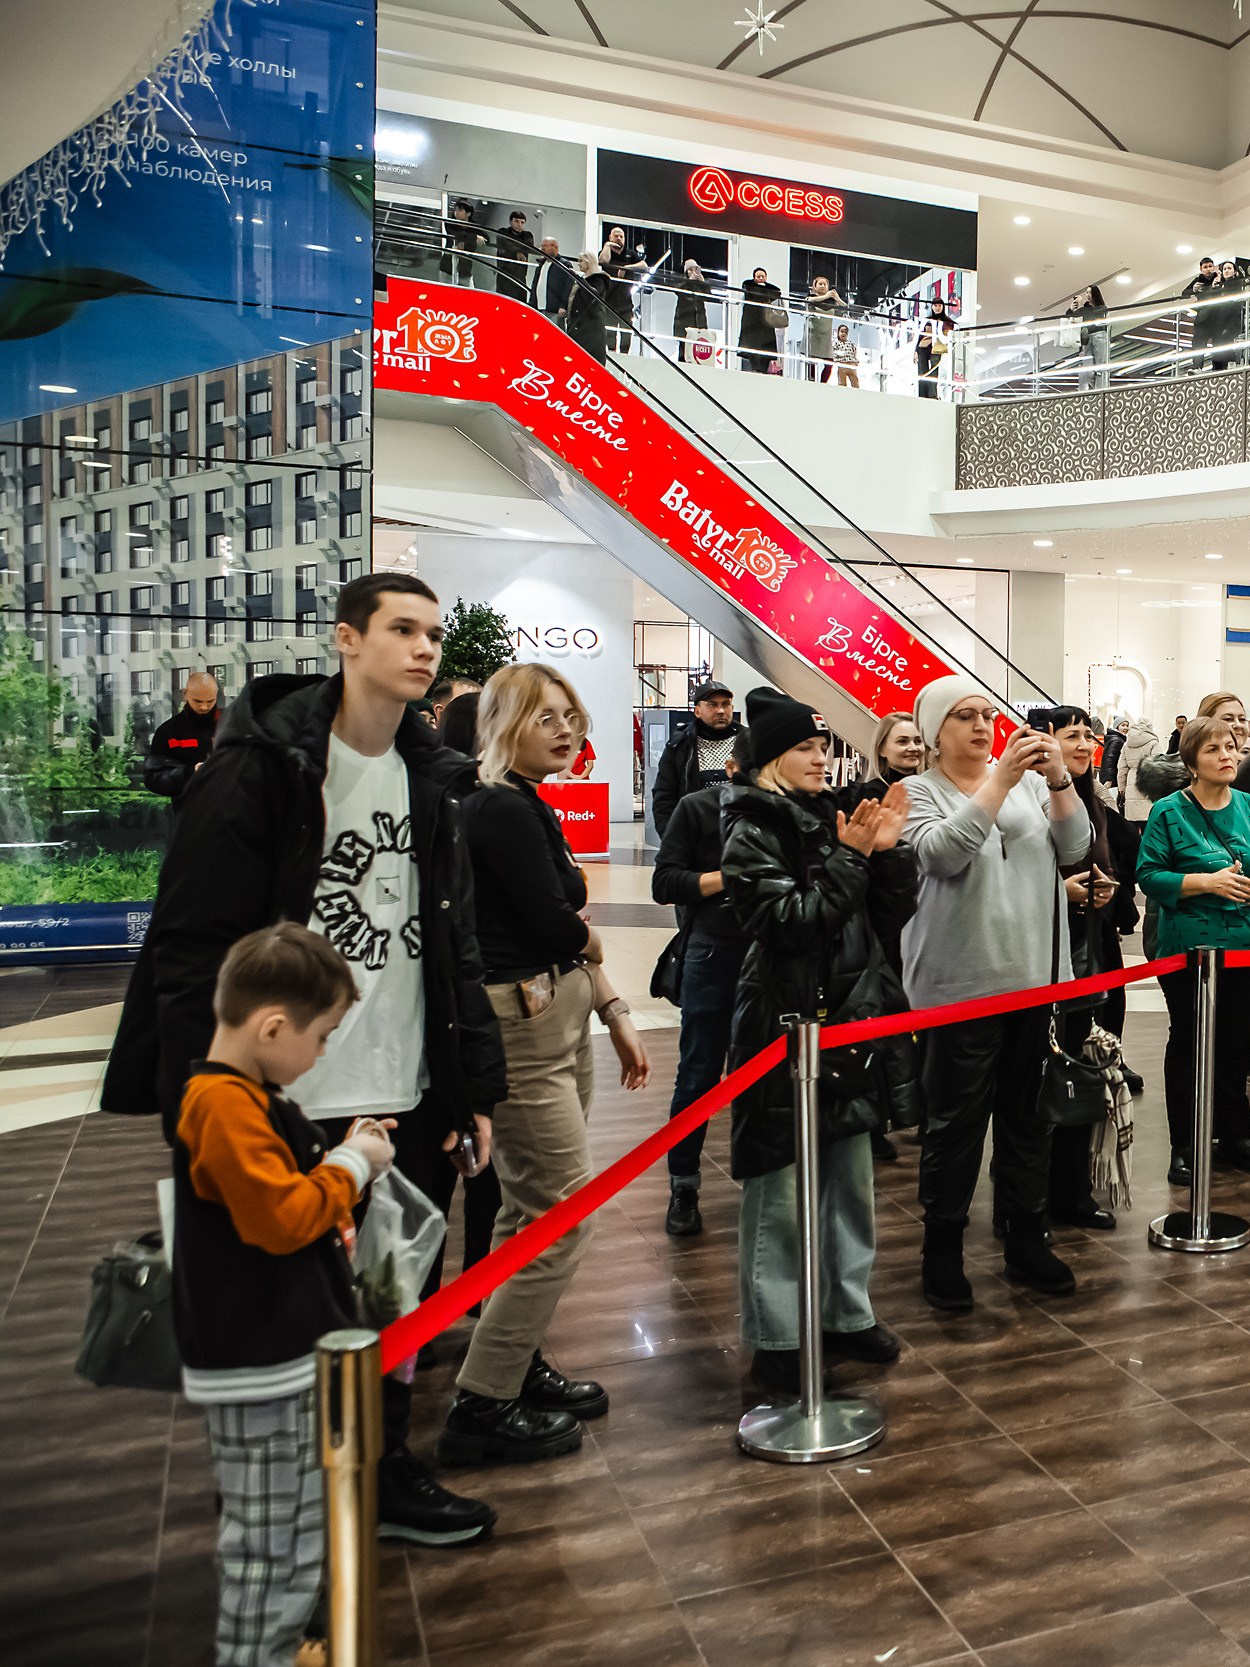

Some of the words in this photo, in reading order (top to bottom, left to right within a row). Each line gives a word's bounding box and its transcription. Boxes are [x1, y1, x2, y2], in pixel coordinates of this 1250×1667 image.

[228, 56, 296, 79] холлы
[177, 143, 248, 167] камер
[690, 166, 844, 222] ACCESS
[382, 353, 431, 372] mall
[506, 358, 629, 451] Вместе
[565, 372, 624, 429] Бірге
[660, 478, 735, 551] Batyr
[708, 547, 746, 581] mall
[517, 626, 599, 649] NGO
[814, 617, 913, 691] Вместе
[861, 624, 908, 672] Бірге
[567, 810, 596, 821] Red+
